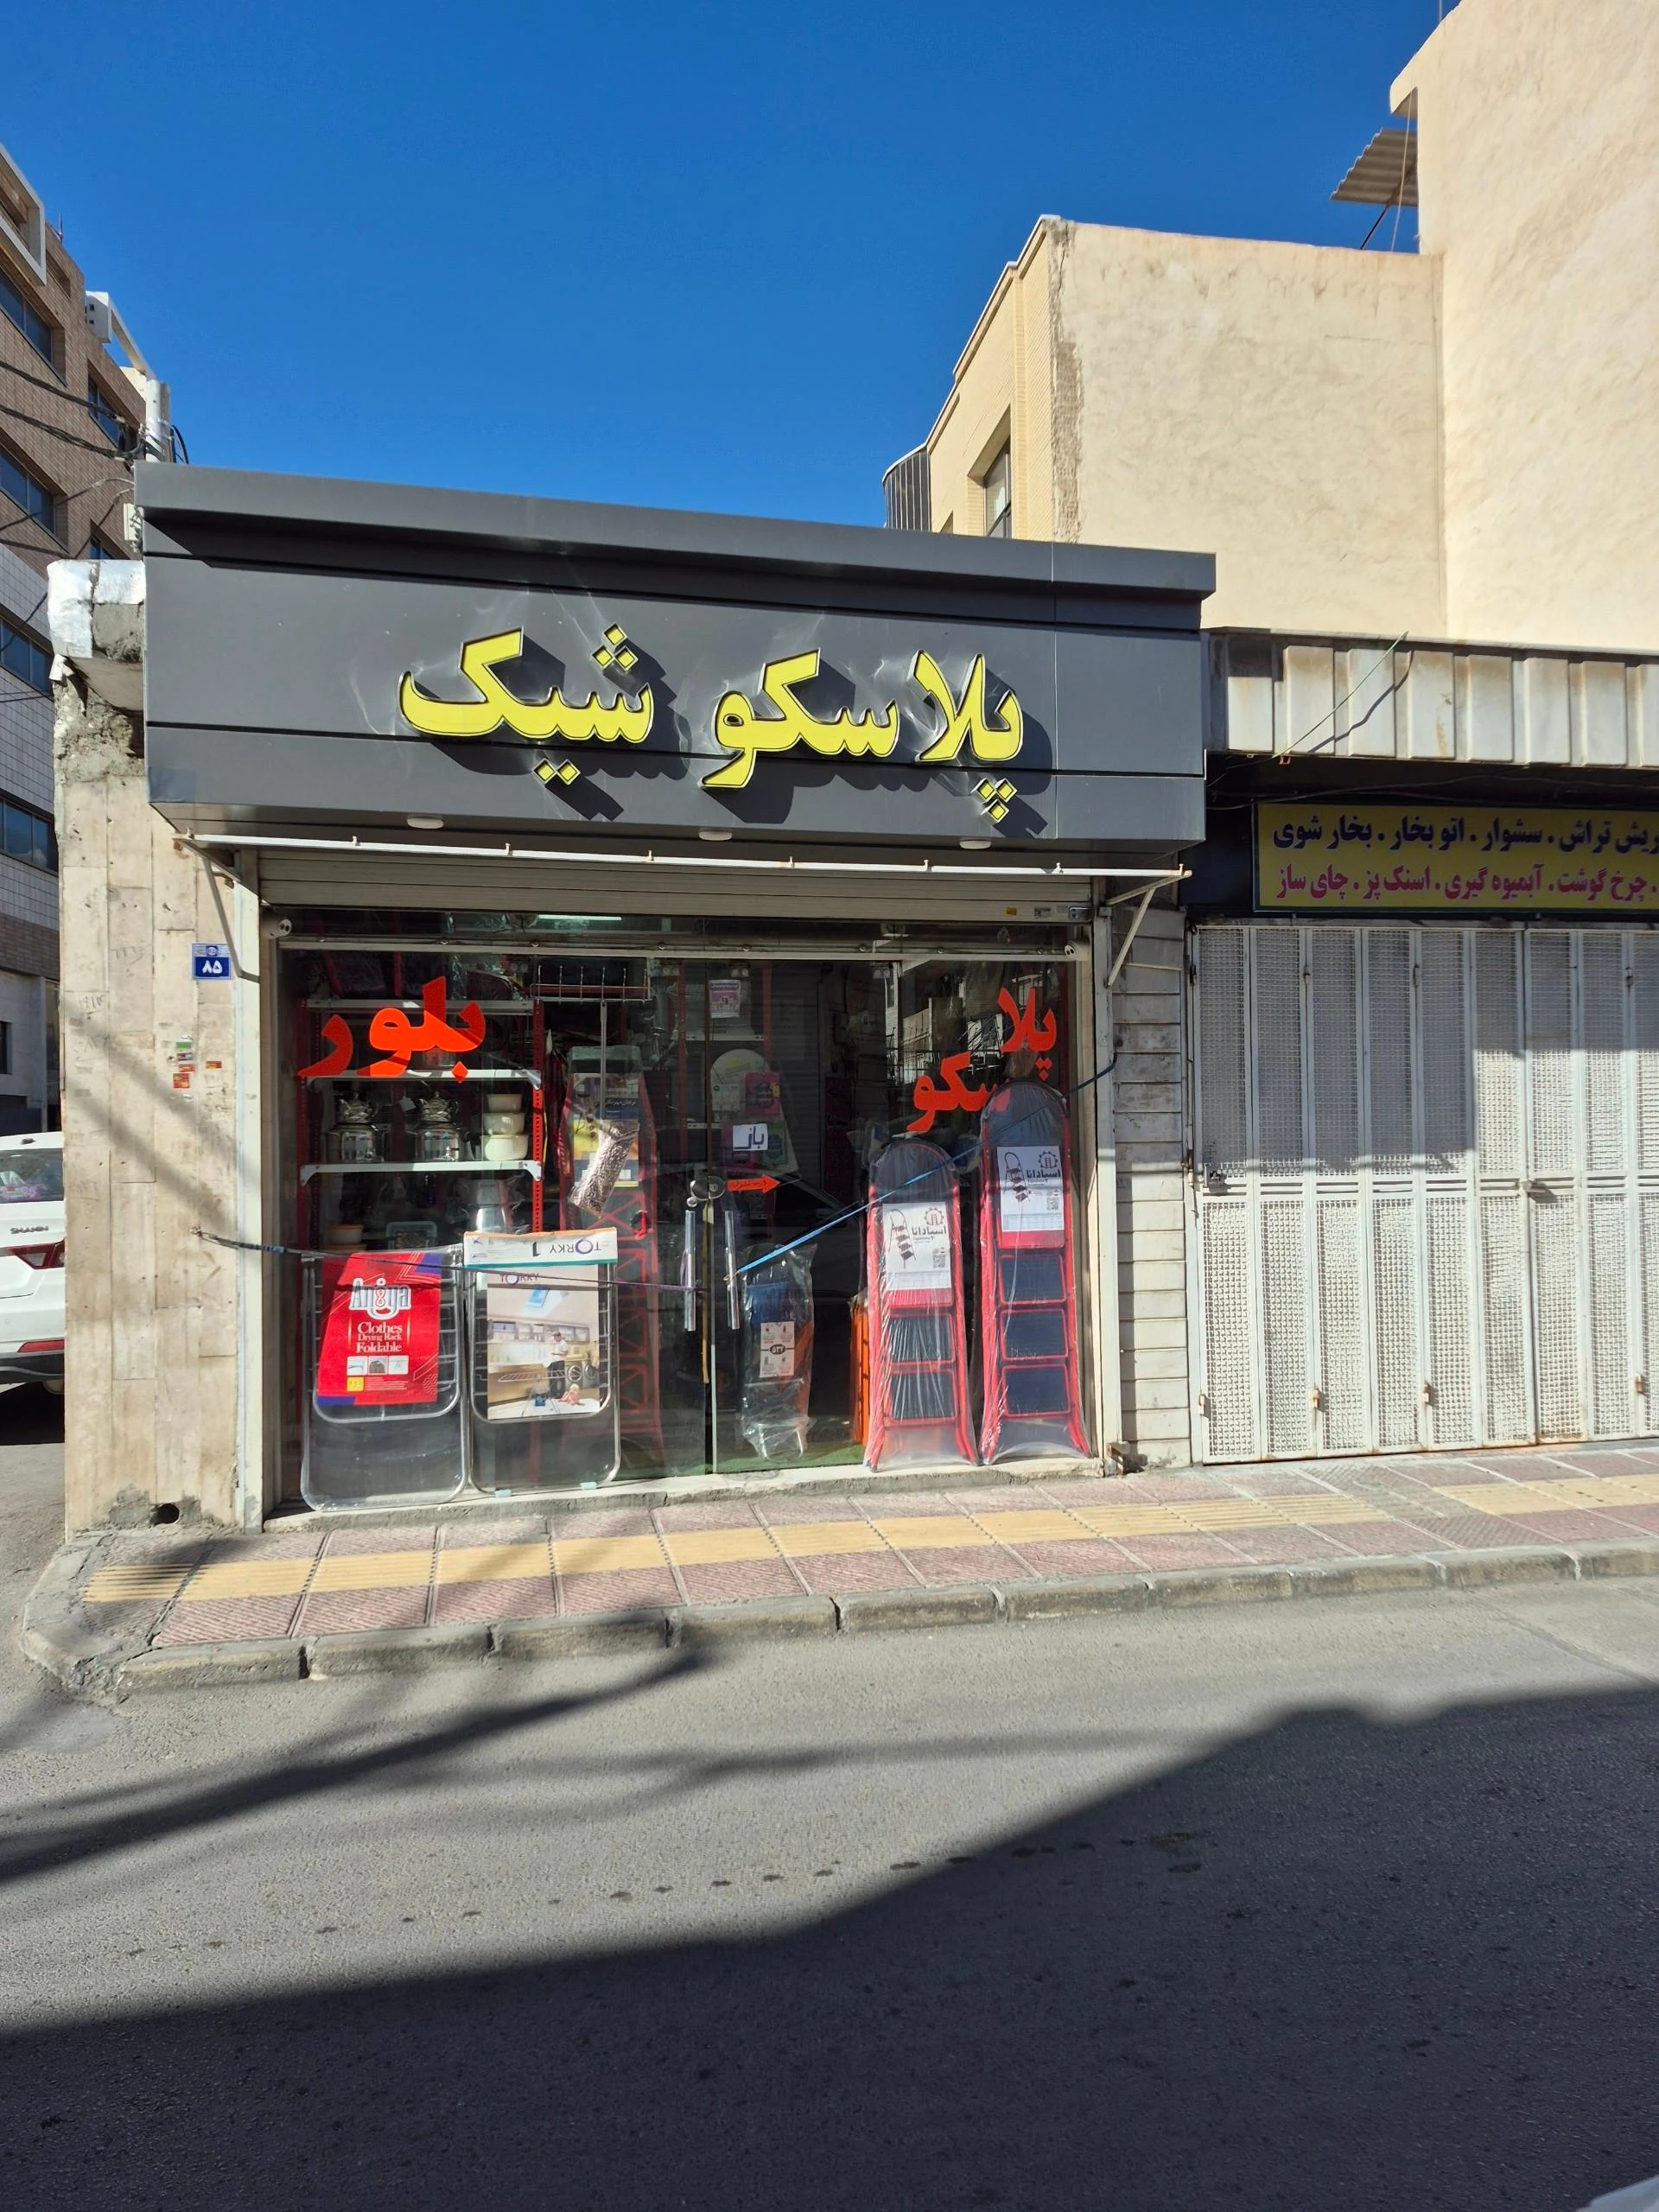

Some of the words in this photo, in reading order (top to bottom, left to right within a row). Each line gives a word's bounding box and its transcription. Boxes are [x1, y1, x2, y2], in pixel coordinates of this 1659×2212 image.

[397, 623, 655, 785] شیک
[1389, 816, 1433, 850] بخار
[1439, 816, 1465, 850] اتو
[1481, 817, 1542, 852] سشوار
[1558, 868, 1607, 900] گوشت
[1611, 870, 1649, 902] چرخ
[202, 960, 223, 974] ۸۵
[297, 976, 486, 1084] بلور
[734, 1126, 765, 1150] باز
[550, 1237, 602, 1254] TORKY
[357, 1321, 403, 1334] Clothes
[358, 1333, 383, 1342] Drying
[356, 1342, 403, 1353] Foldable
